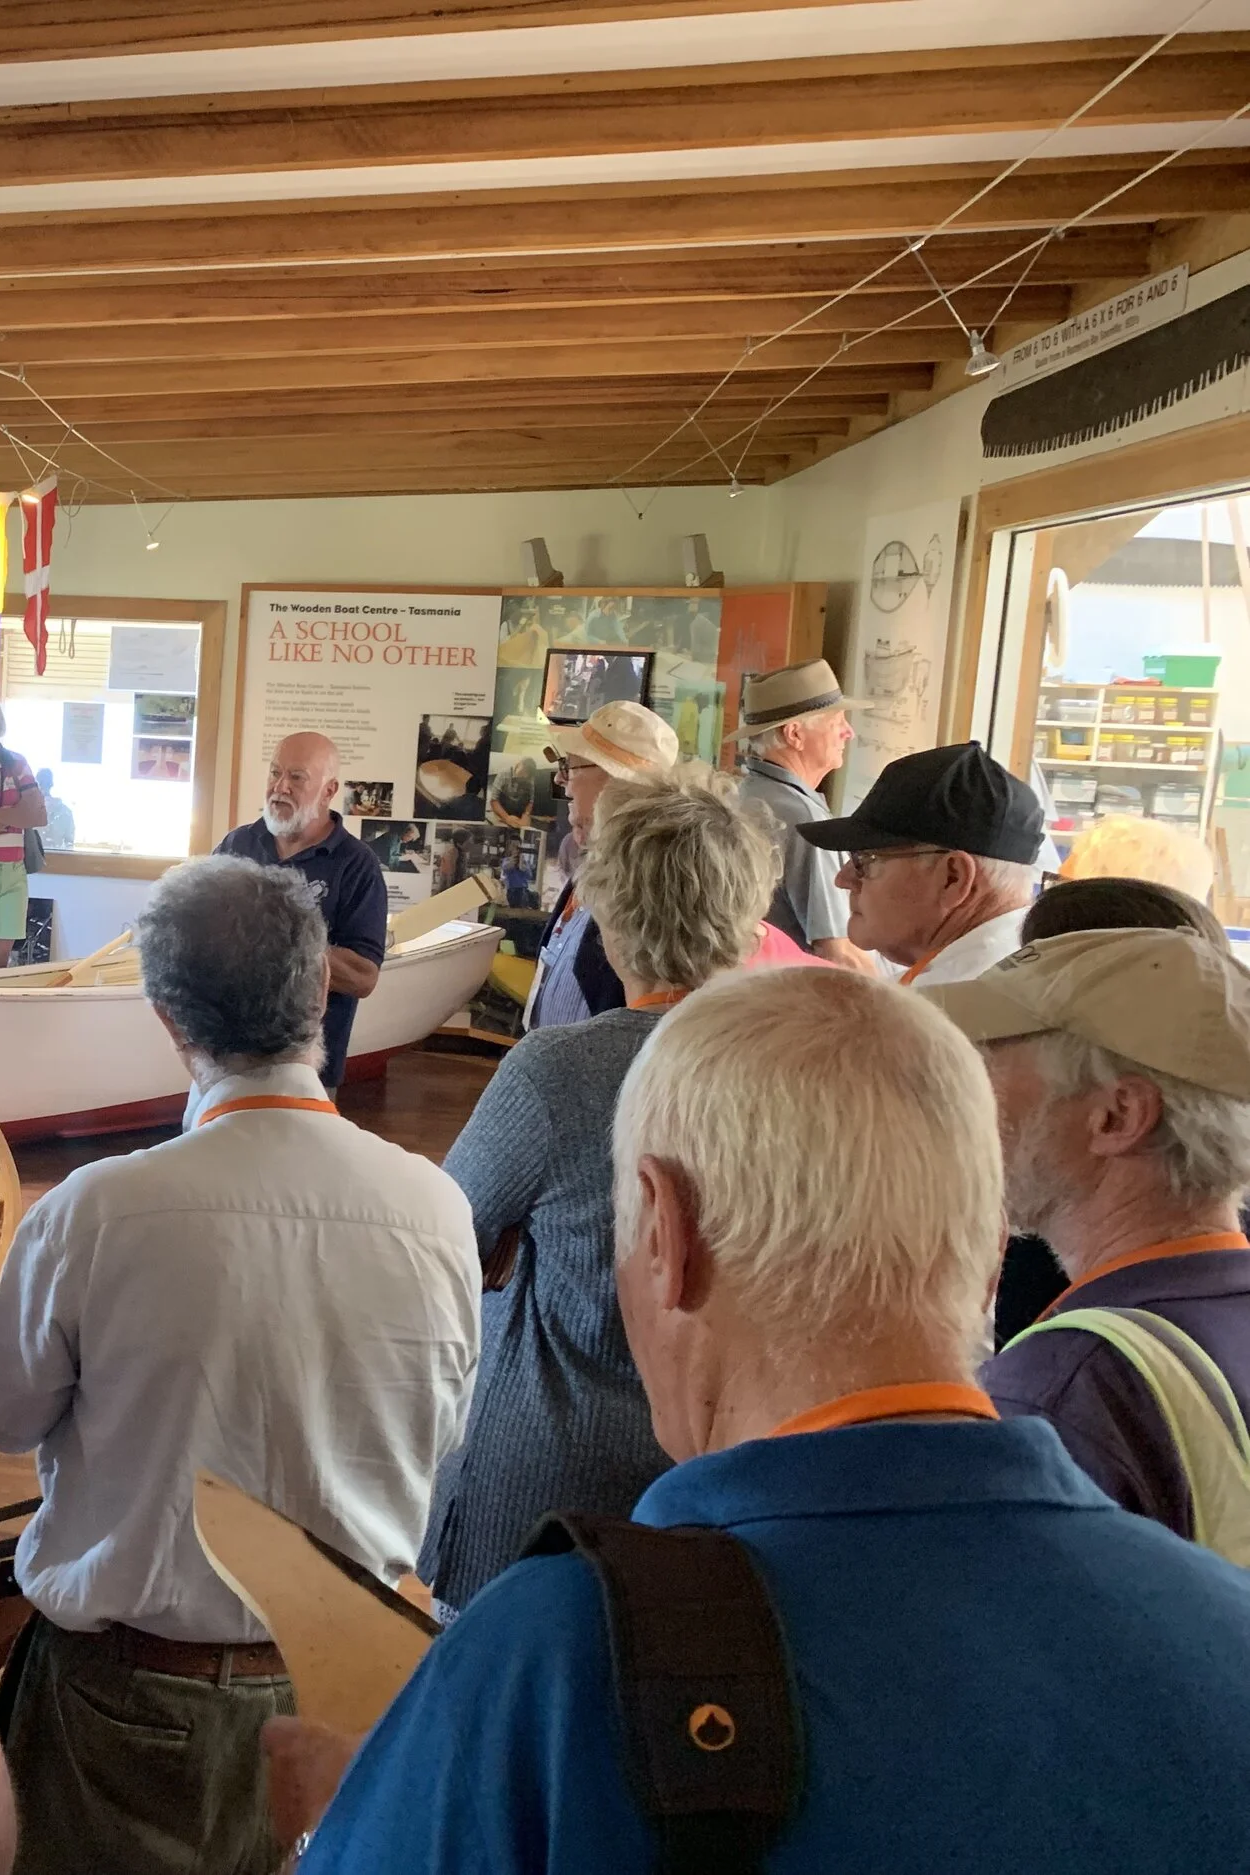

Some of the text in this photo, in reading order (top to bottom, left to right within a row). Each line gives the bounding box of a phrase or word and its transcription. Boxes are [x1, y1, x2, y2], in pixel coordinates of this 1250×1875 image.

[1013, 344, 1033, 364] FROM
[1041, 335, 1051, 351] TO
[1053, 331, 1059, 346] 6
[1061, 322, 1082, 342] WITH
[1084, 317, 1090, 330] A
[1091, 313, 1098, 328] 6
[1099, 309, 1105, 324] X
[1108, 305, 1113, 320] 6
[1116, 295, 1135, 316] FOR
[1137, 291, 1143, 307] 6
[1146, 279, 1168, 303] AND
[269, 603, 288, 613] The
[290, 604, 332, 613] Wooden
[334, 605, 360, 614] Boat
[362, 605, 398, 615] Centre
[408, 606, 462, 617] Tasmania
[269, 620, 407, 642] A SCHOOL
[268, 642, 478, 667] LIKE NO OTHER
